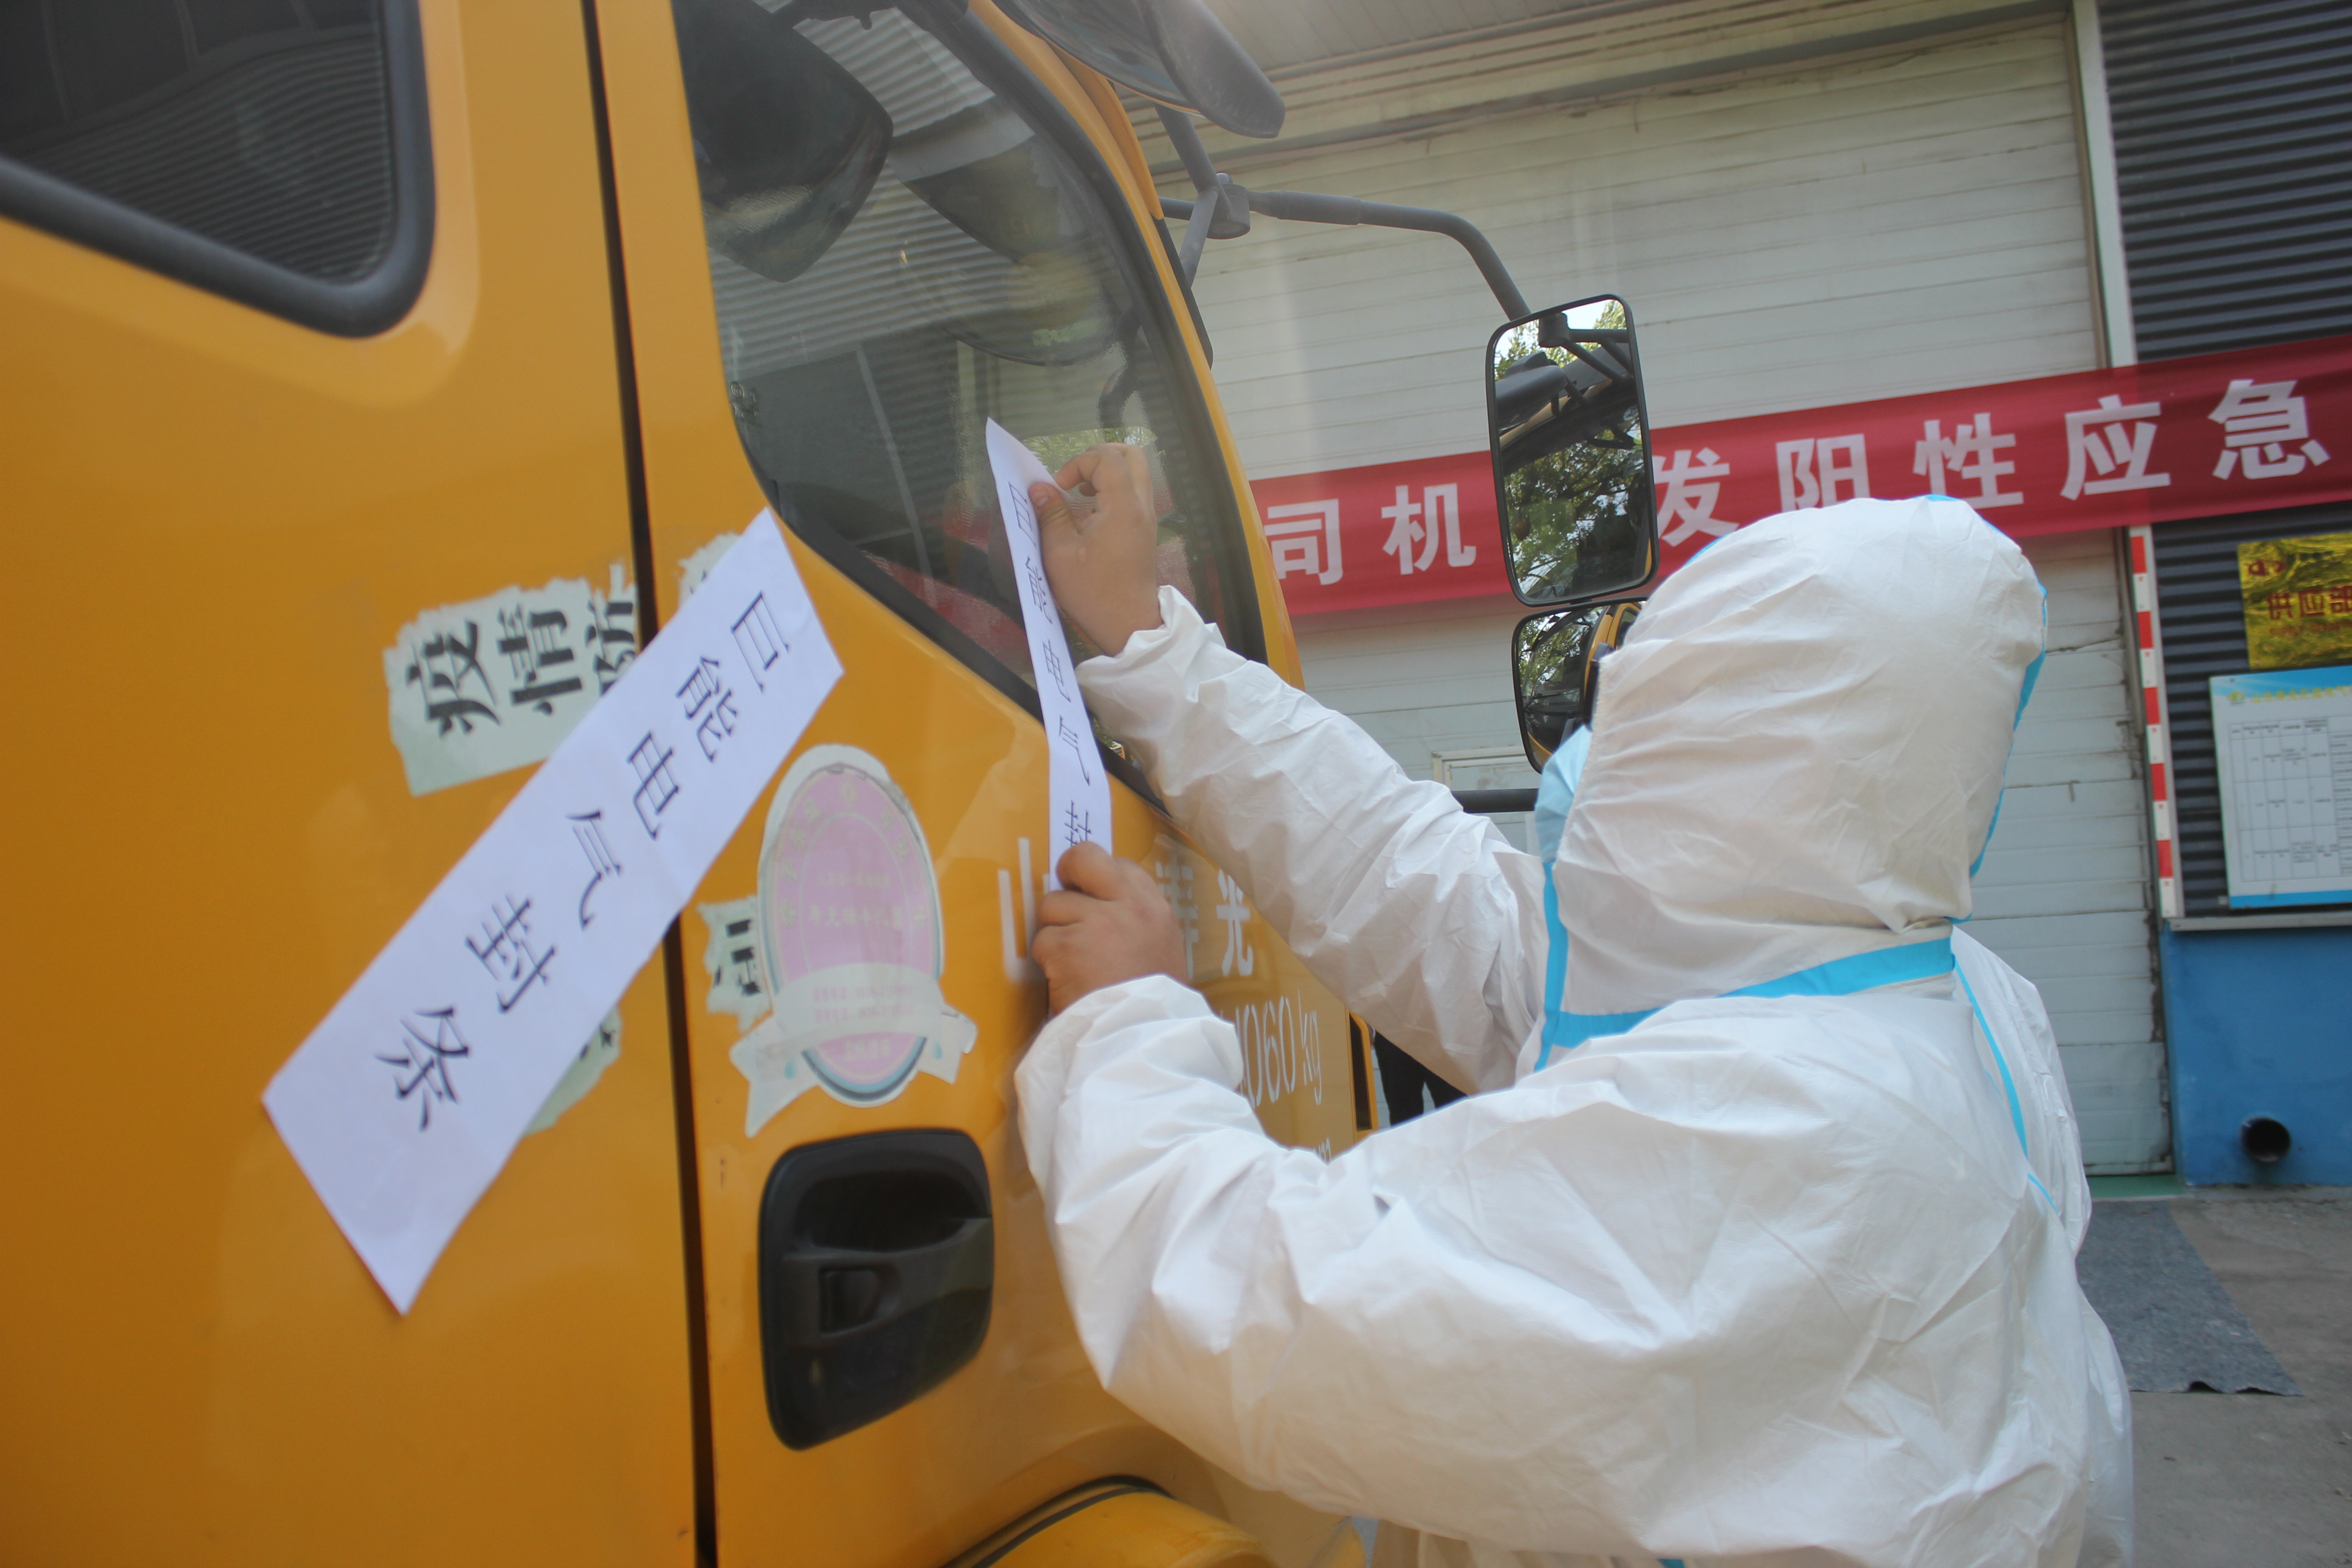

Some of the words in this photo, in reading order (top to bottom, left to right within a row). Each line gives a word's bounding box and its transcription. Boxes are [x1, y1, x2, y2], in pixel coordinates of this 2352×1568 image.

[1264, 379, 2331, 585] 司机发阳性应急
[374, 591, 791, 1132] 巨能电气封条
